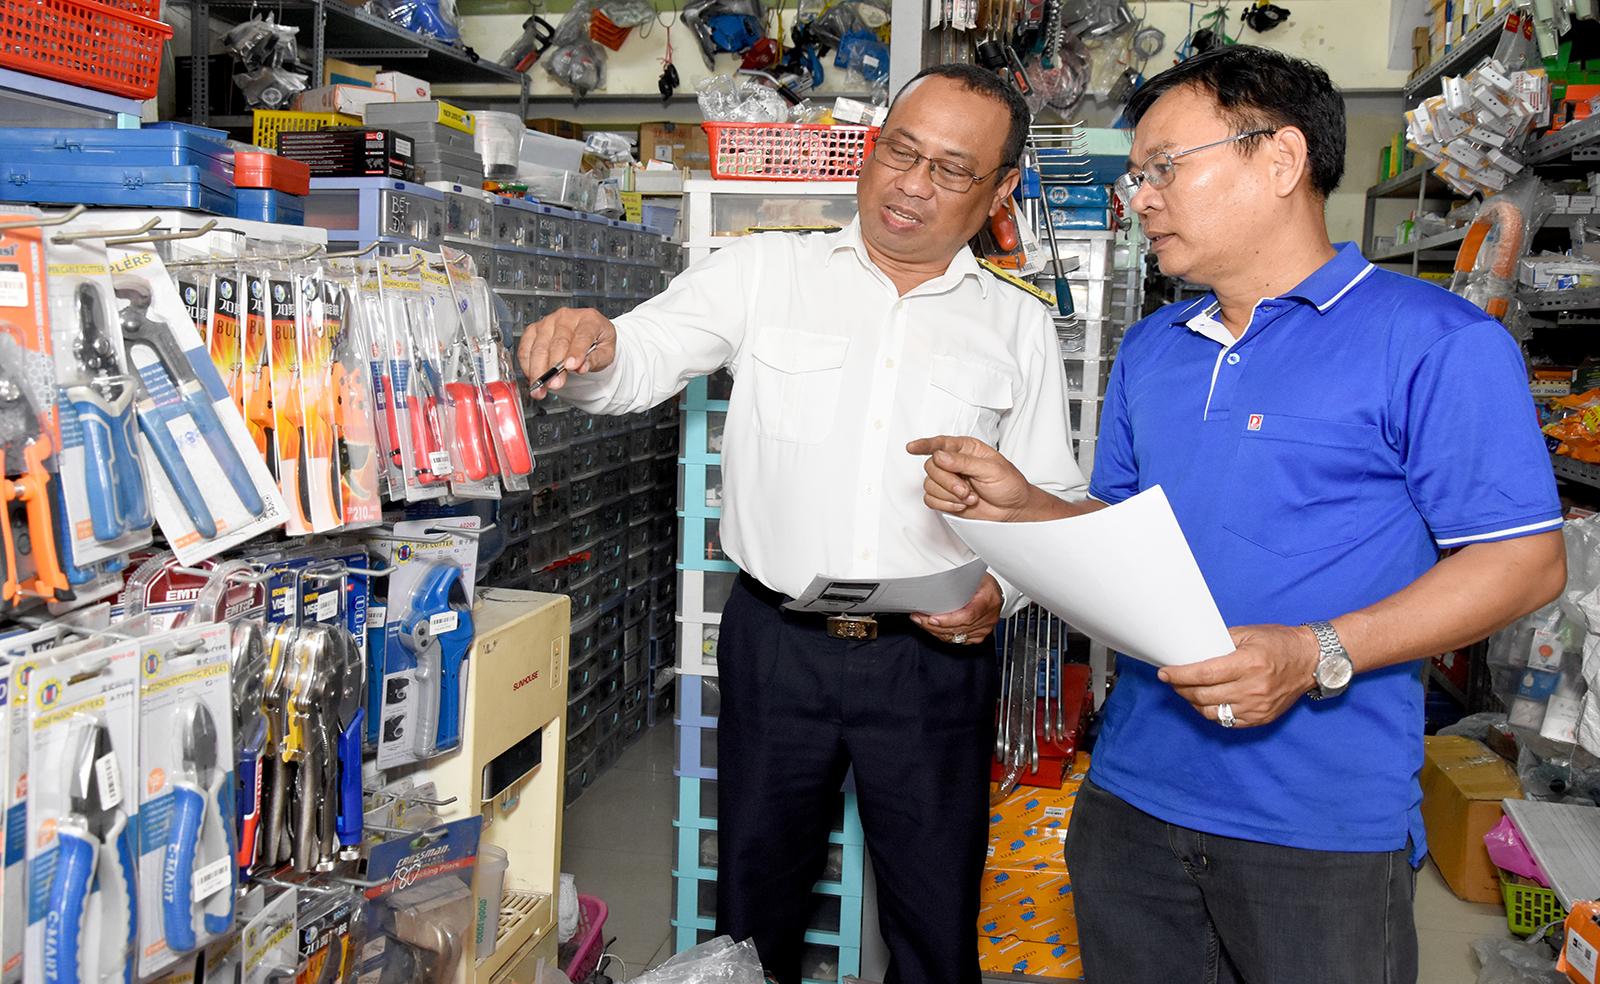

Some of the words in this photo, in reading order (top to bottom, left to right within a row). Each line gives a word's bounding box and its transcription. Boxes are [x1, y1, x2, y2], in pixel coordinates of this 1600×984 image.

[225, 598, 255, 618] EMTOP
[164, 843, 179, 904] C-MART
[46, 911, 60, 981] C-MART
